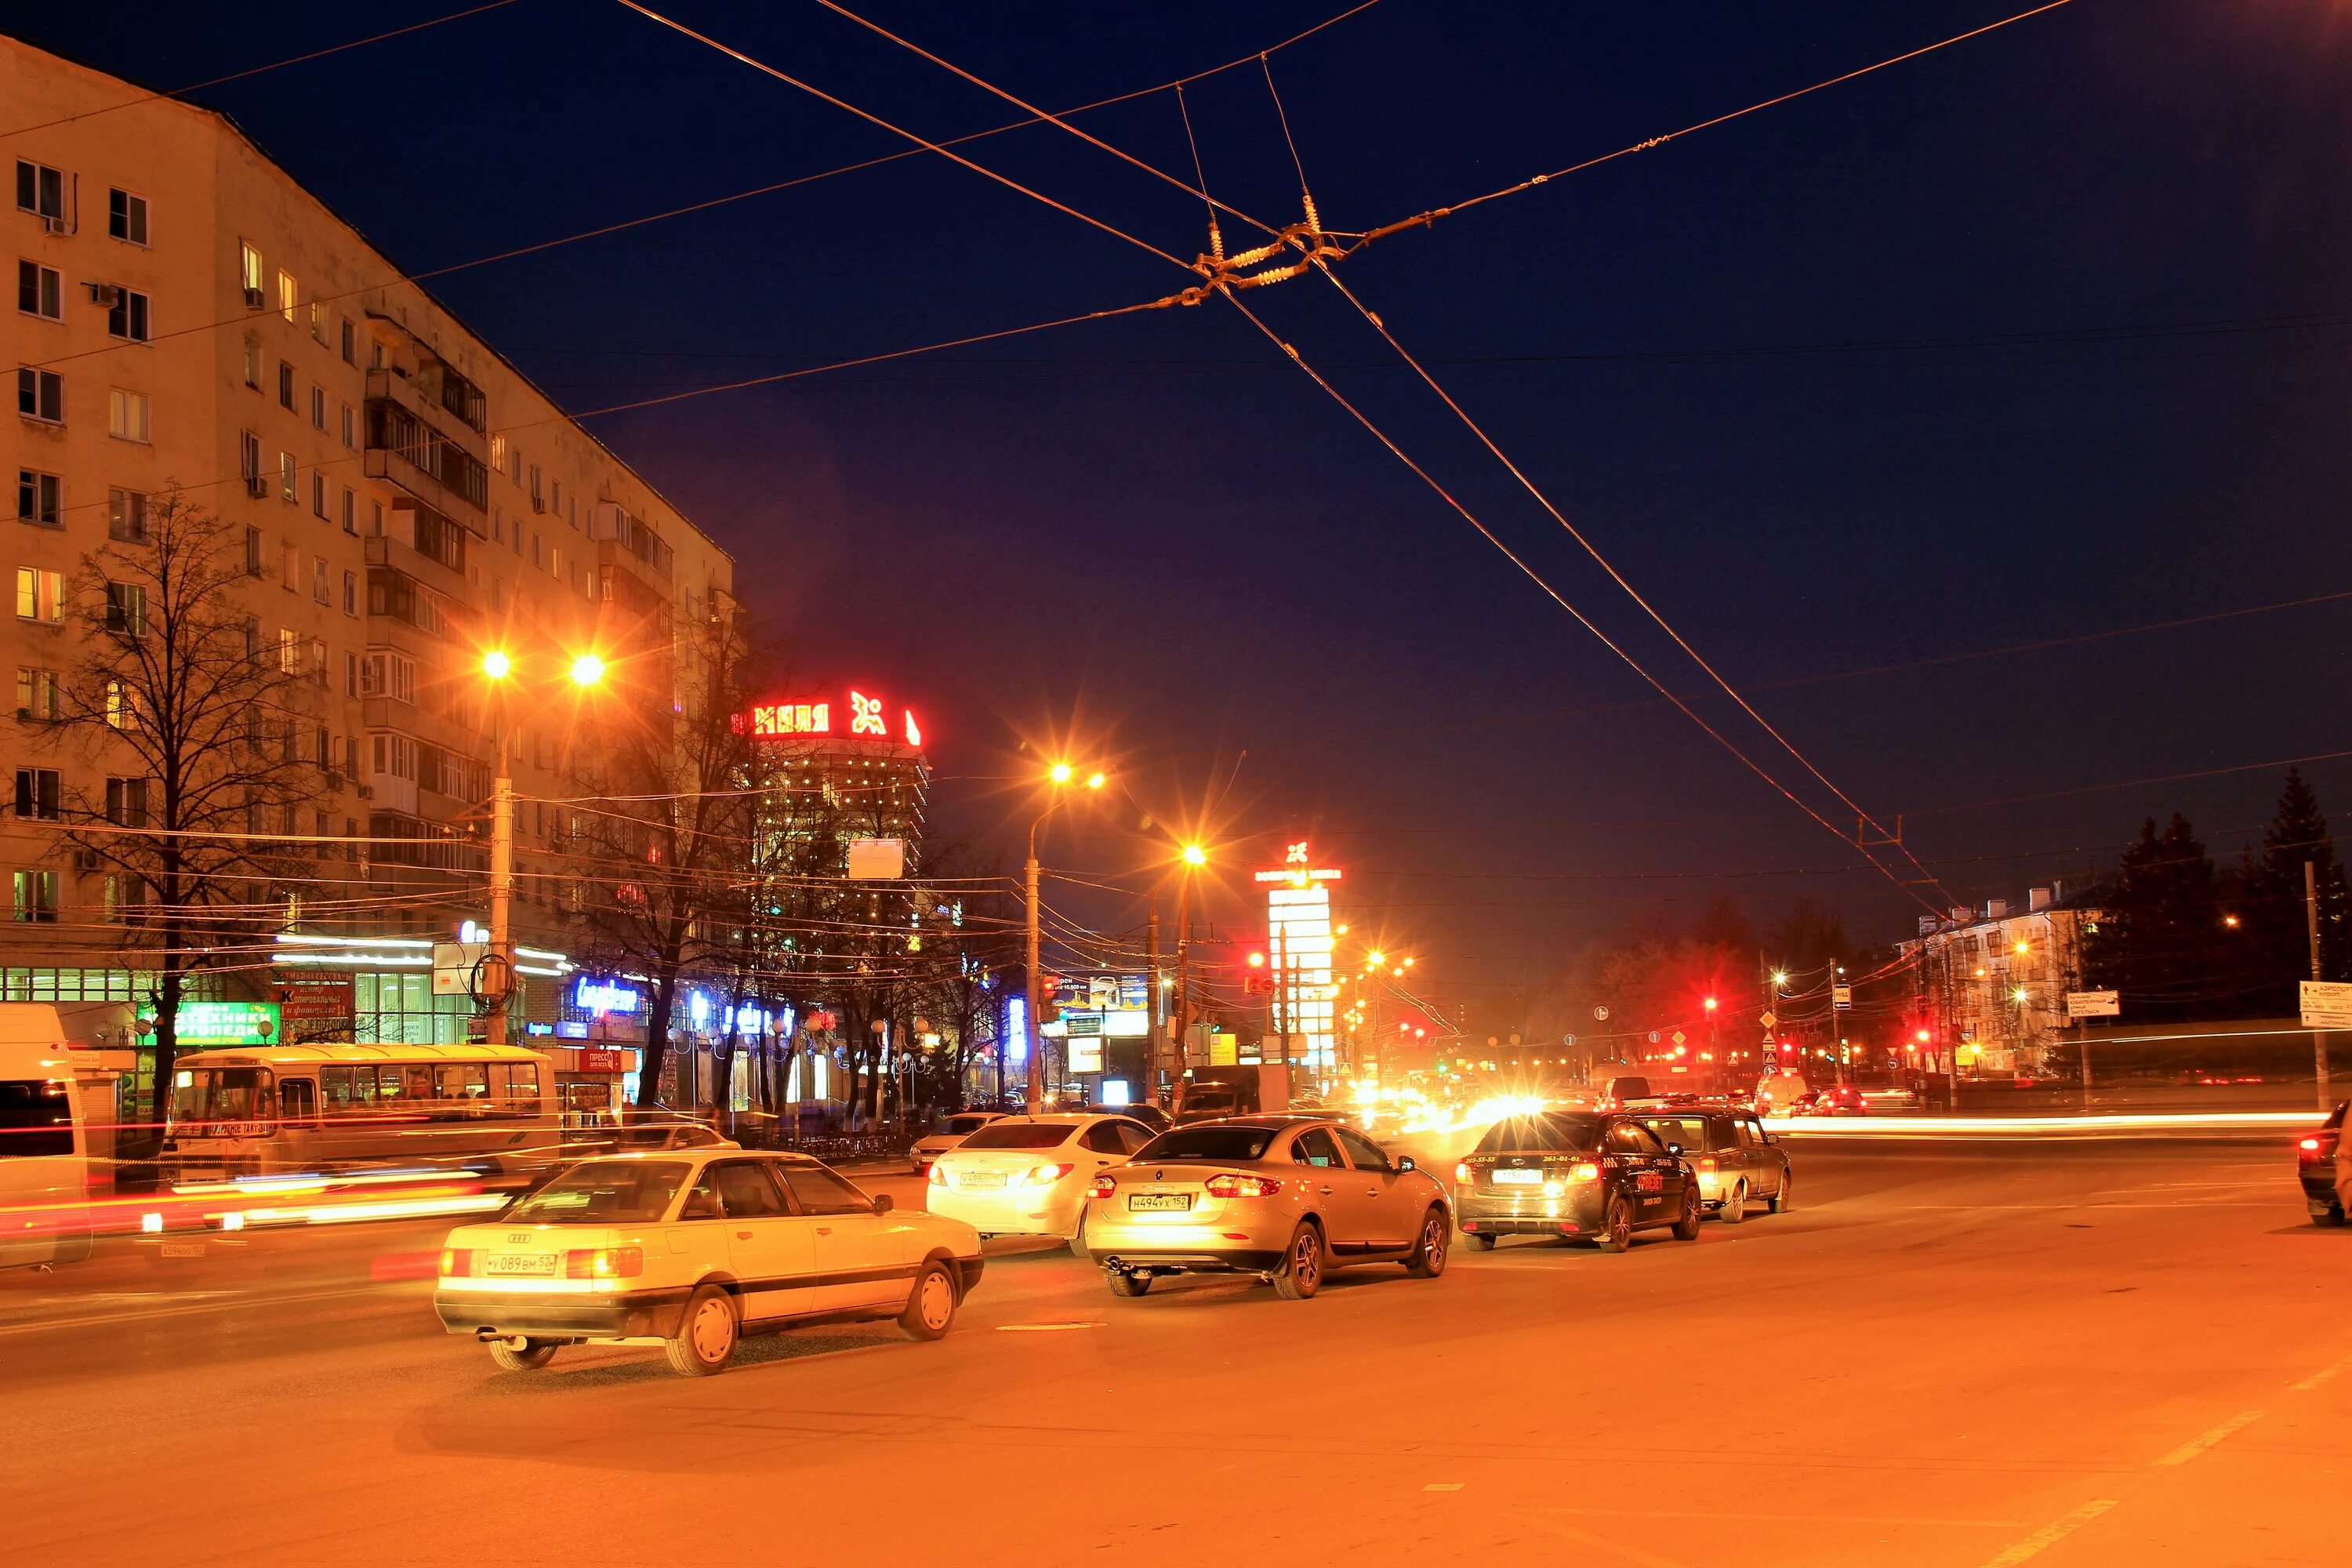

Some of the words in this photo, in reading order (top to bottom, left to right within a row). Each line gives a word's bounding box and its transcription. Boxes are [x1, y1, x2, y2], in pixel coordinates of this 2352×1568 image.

[590, 1051, 613, 1062] ПРЕССА
[1134, 1198, 1171, 1208] Н494УХ
[1172, 1197, 1187, 1206] 152
